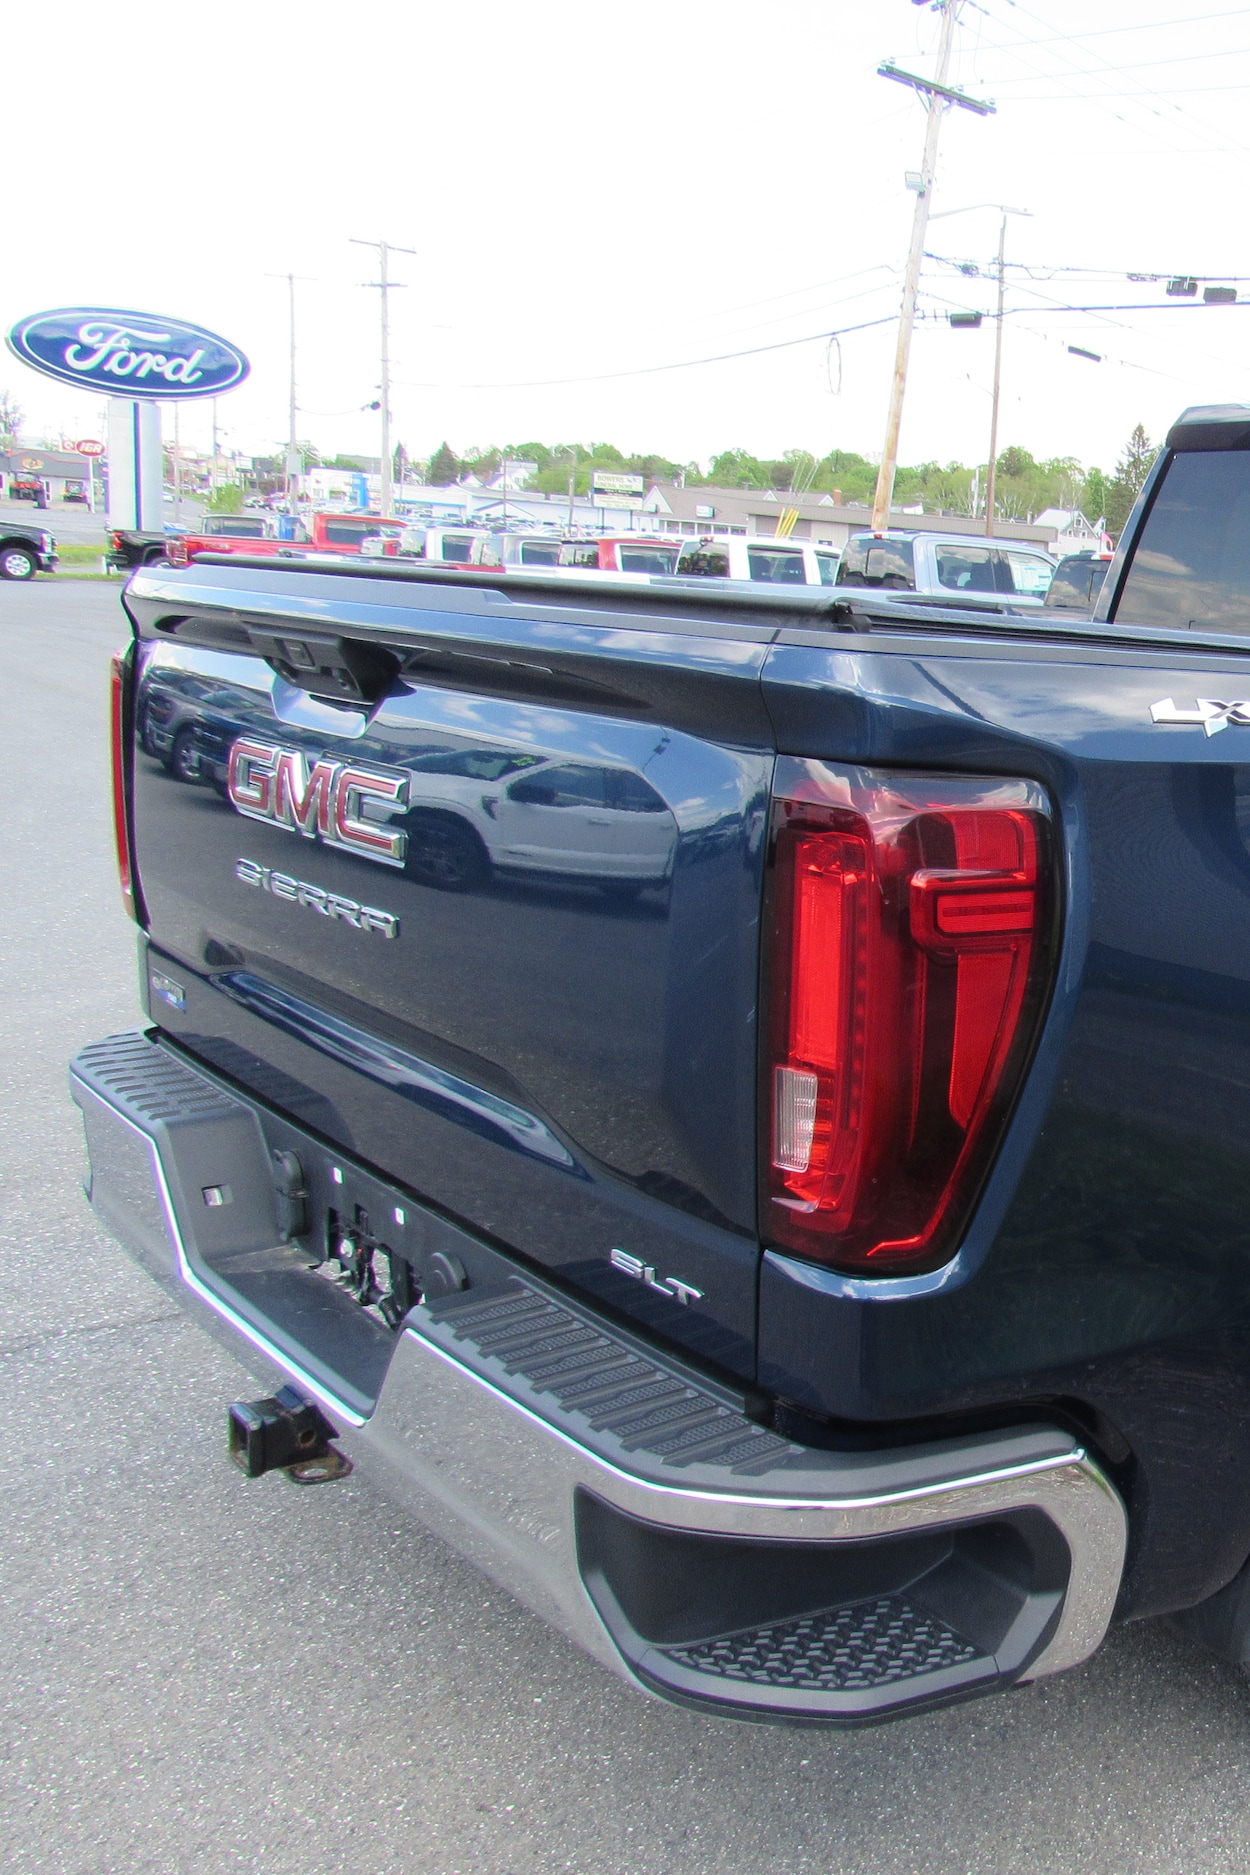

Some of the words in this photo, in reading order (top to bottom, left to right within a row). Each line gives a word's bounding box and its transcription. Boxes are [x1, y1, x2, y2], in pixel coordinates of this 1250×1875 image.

[64, 322, 203, 384] Ford
[79, 442, 102, 453] IGA
[229, 736, 410, 869] GMC
[236, 857, 400, 939] SIERRA
[610, 1247, 704, 1306] SLT
